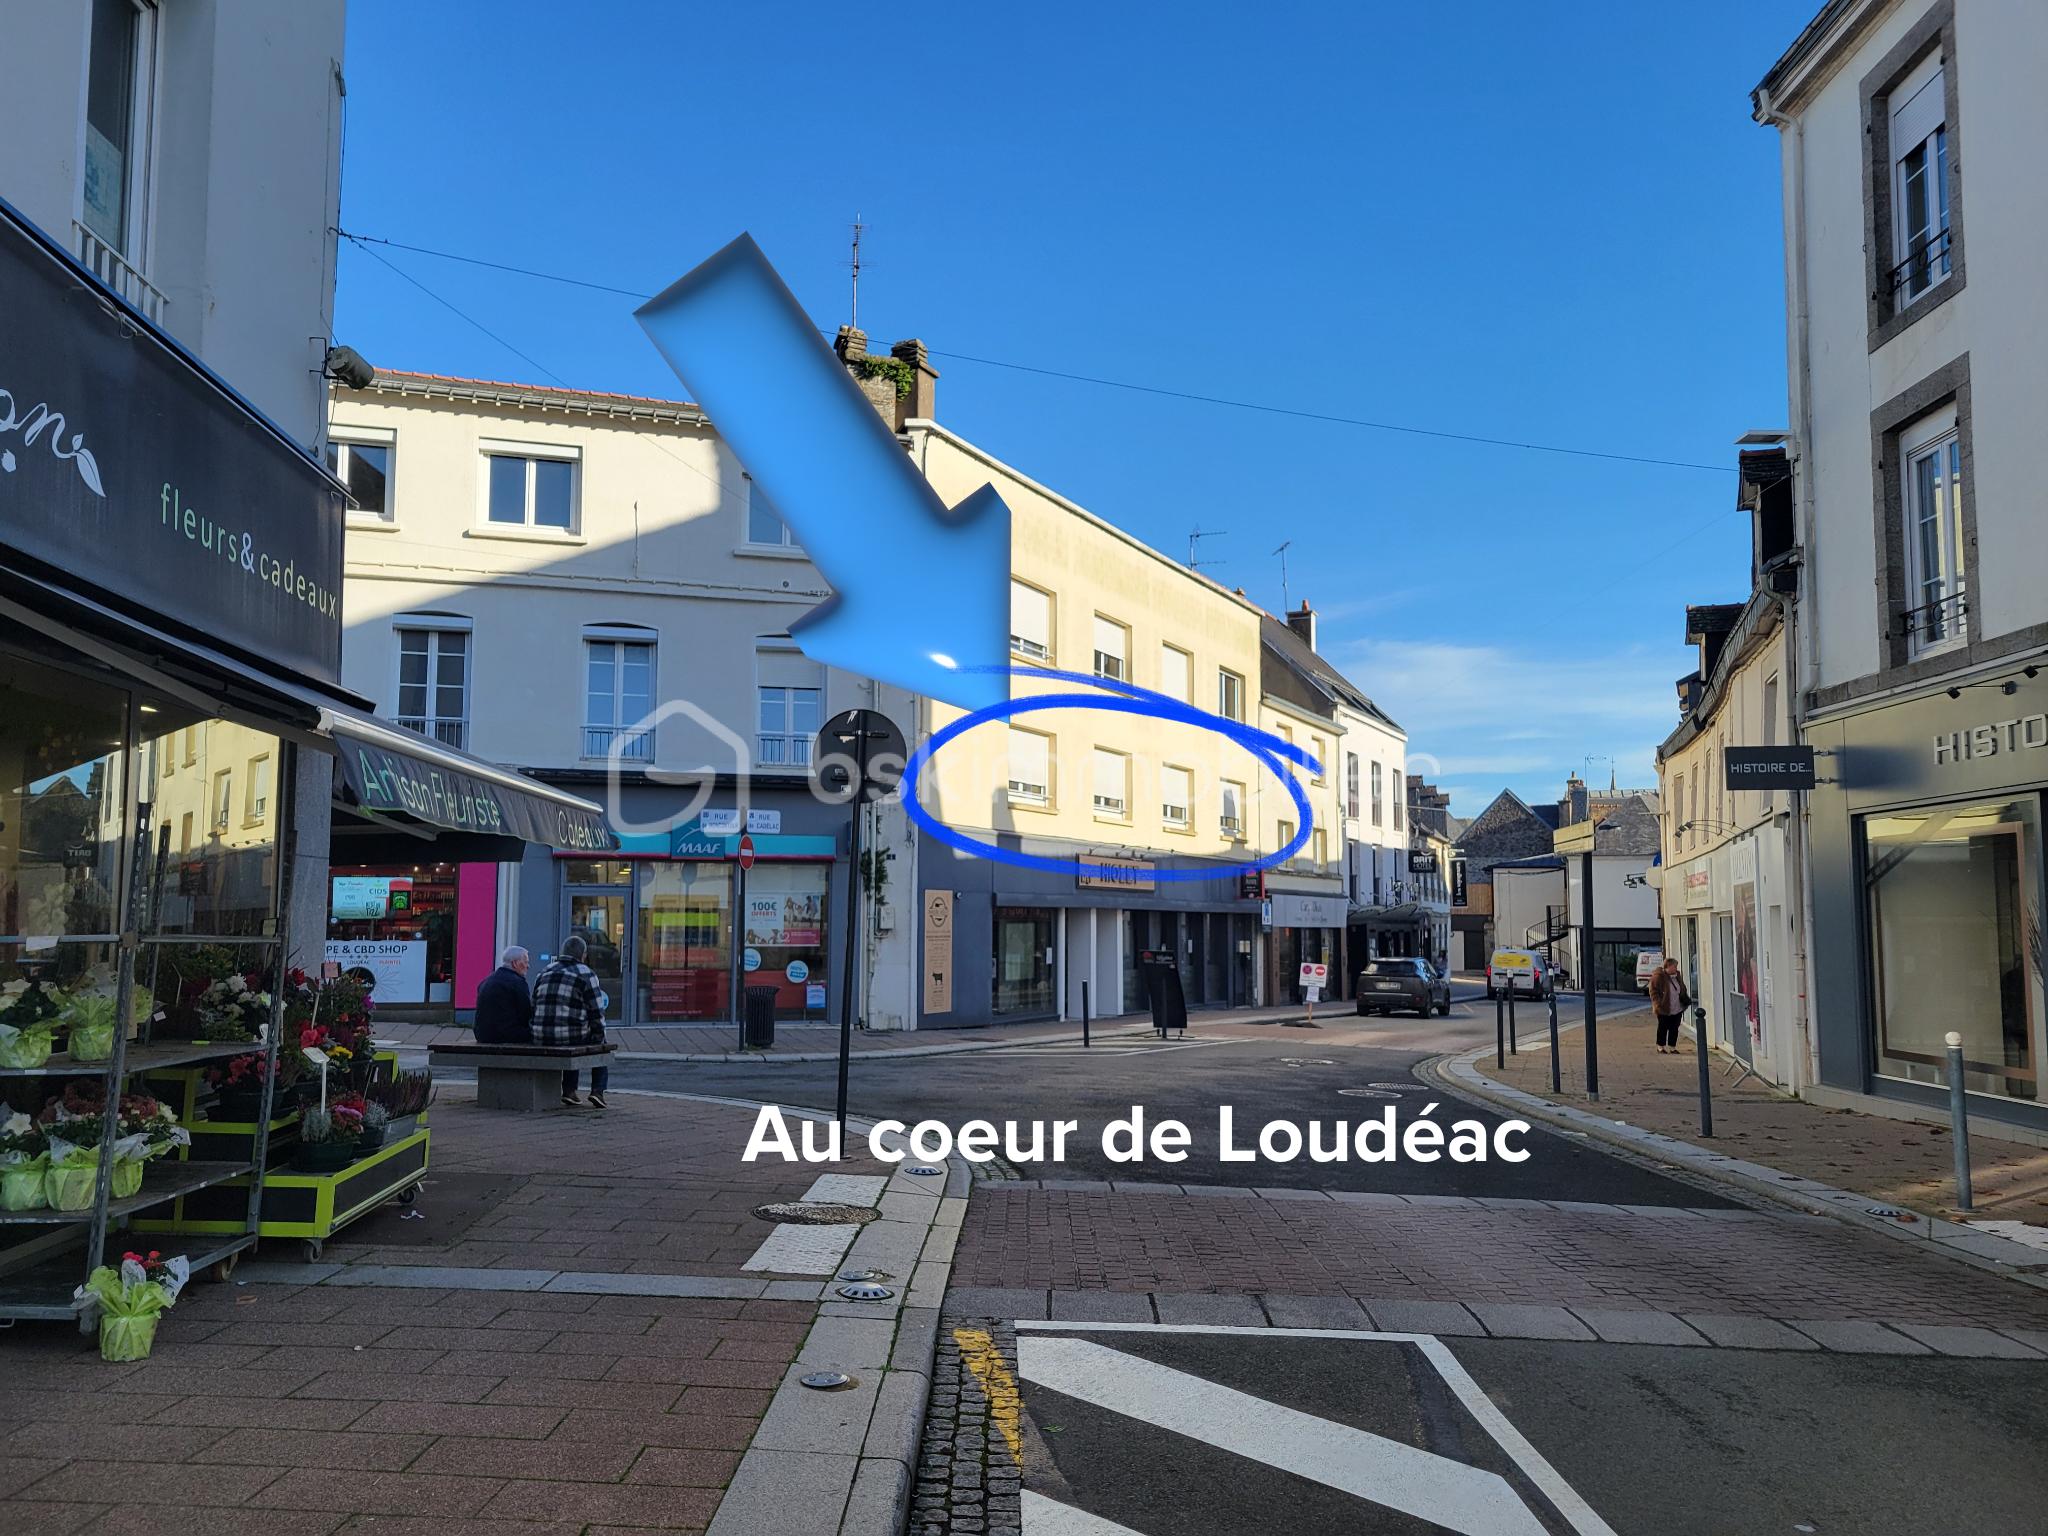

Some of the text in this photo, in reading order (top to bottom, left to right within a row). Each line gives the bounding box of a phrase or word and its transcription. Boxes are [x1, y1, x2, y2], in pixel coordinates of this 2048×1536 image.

[1730, 762, 1787, 774] HISTOIRE
[358, 749, 433, 816] Artisan
[430, 771, 501, 828] Fleuriste
[677, 842, 721, 854] MAAF
[1413, 855, 1433, 863] BRIT
[751, 901, 777, 911] 100€
[342, 945, 351, 954] &
[354, 945, 376, 954] CBD
[378, 945, 408, 954] SHOP
